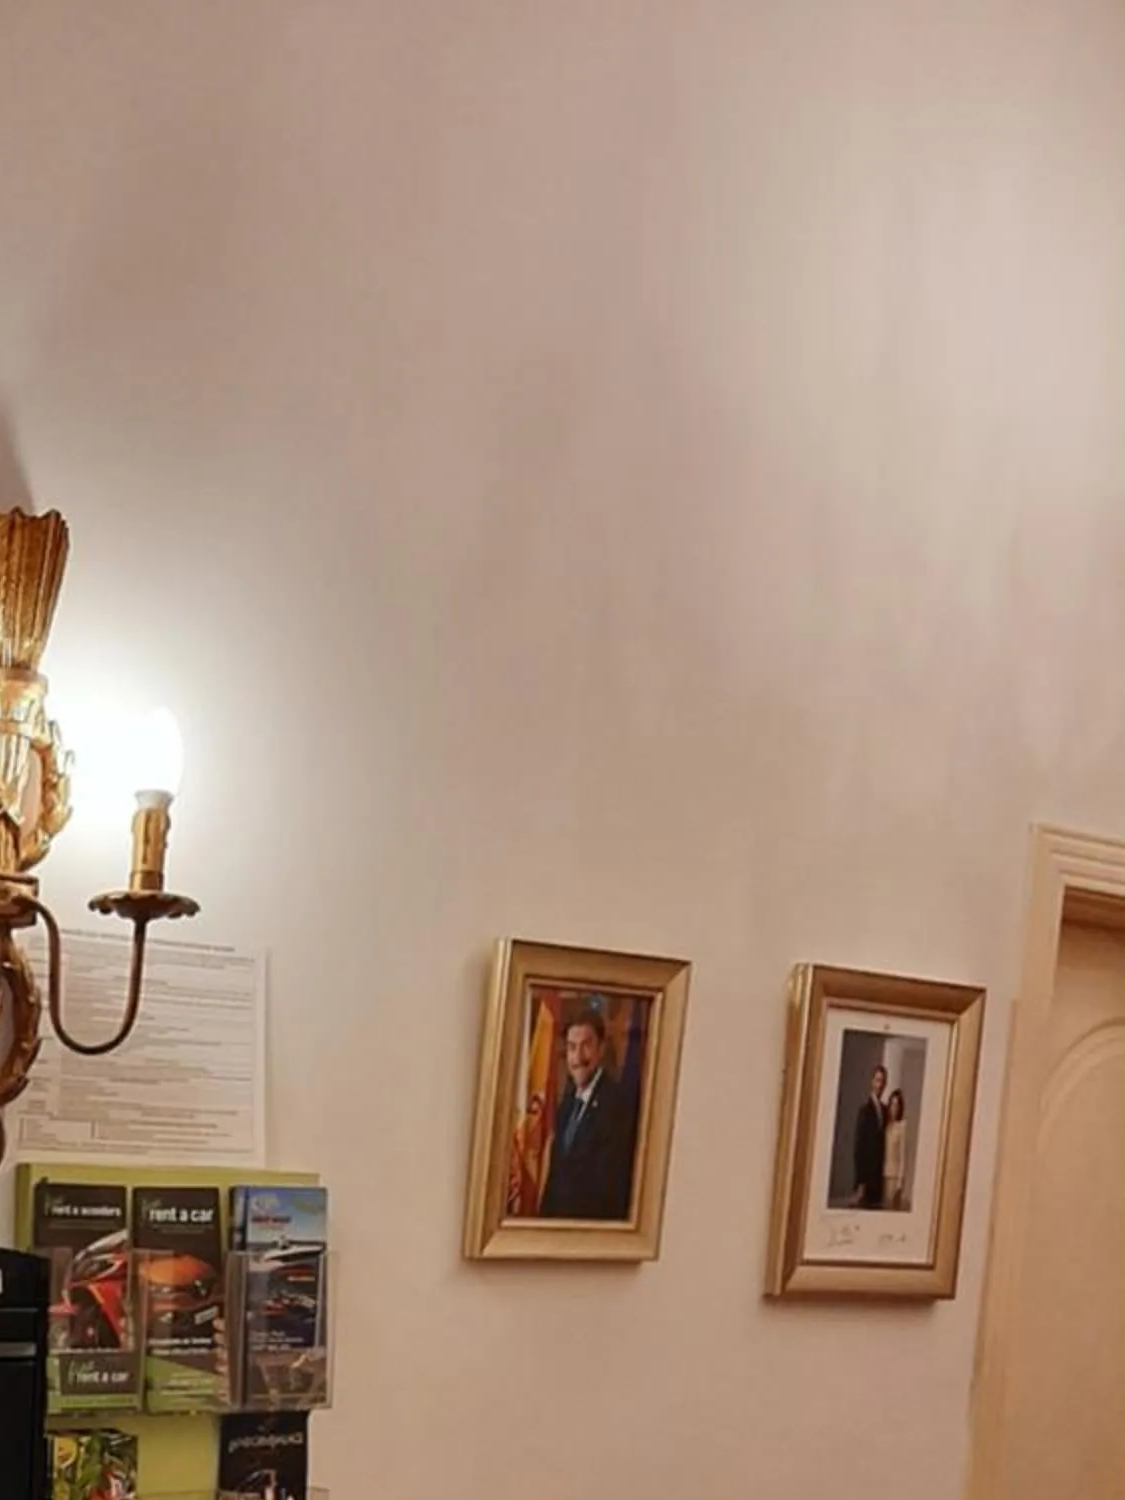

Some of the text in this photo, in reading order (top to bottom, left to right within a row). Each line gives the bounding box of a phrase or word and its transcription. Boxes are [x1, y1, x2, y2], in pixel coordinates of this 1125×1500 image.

[149, 1206, 214, 1223] rent a car
